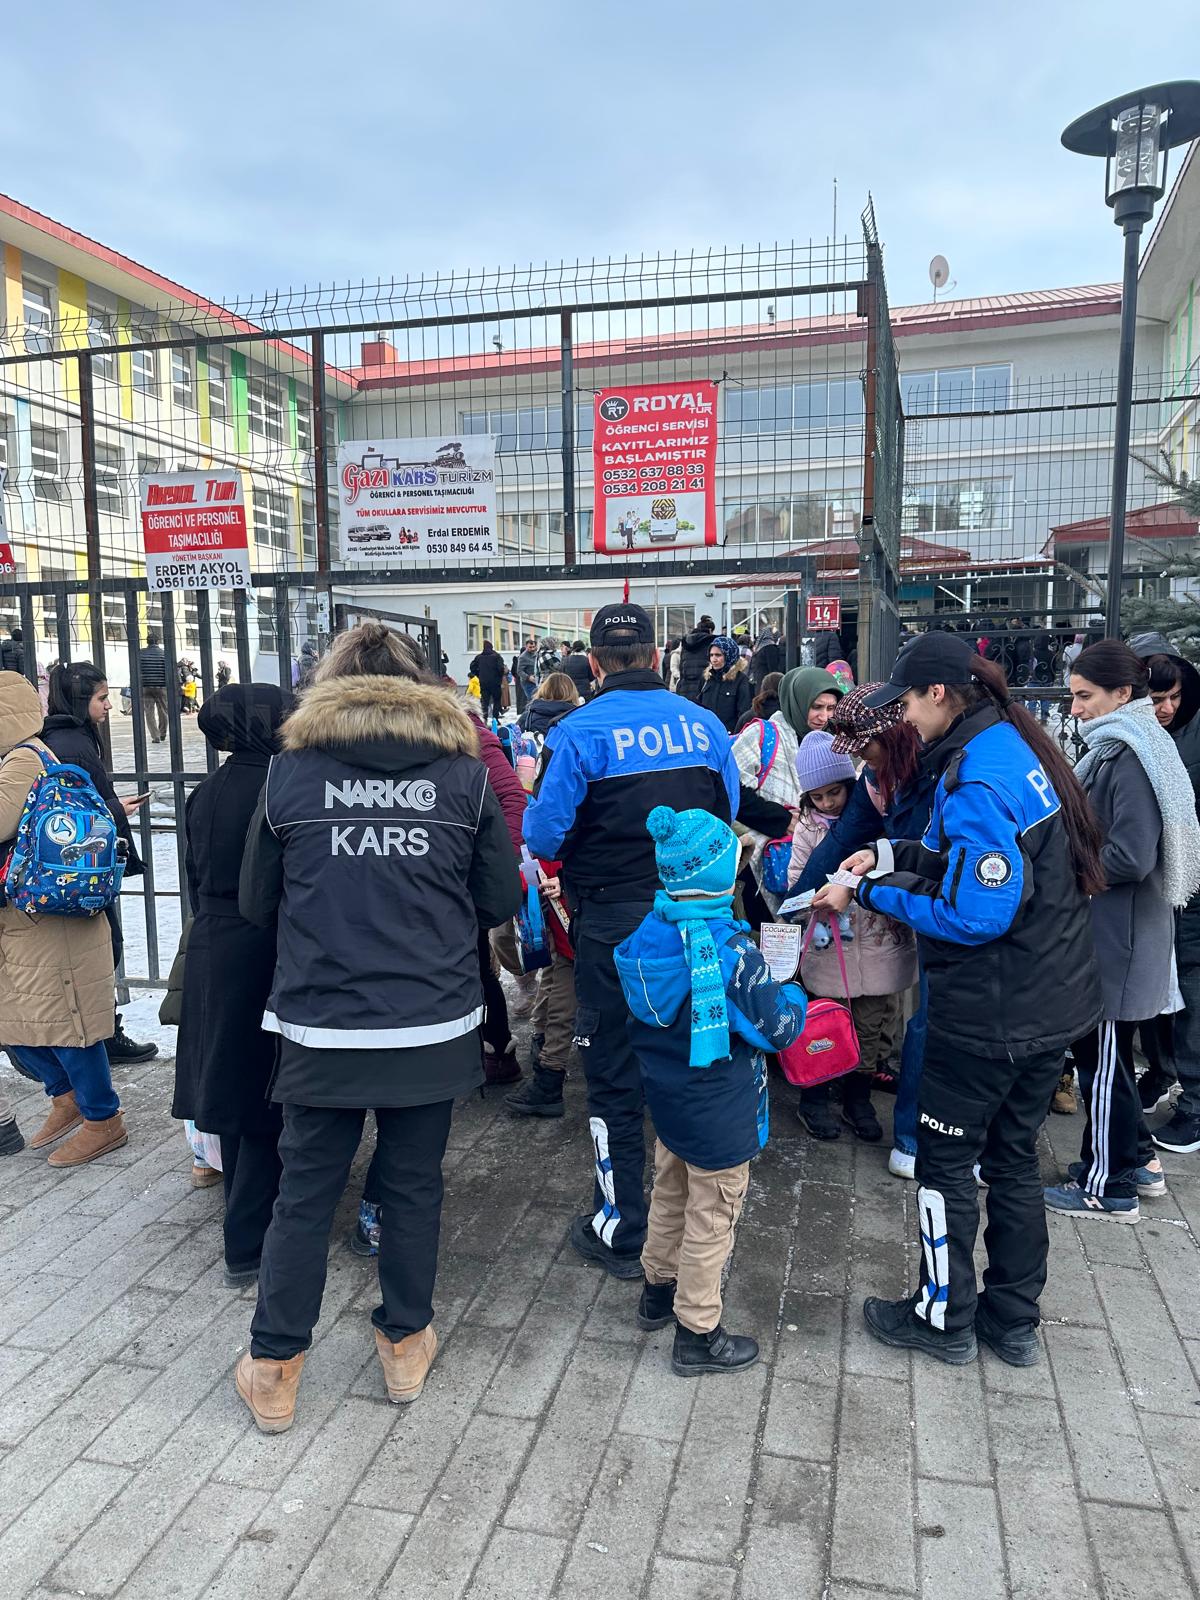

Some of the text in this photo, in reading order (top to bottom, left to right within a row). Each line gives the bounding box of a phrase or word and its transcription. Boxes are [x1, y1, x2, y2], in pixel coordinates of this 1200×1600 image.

[633, 392, 712, 412] ROYAL
[608, 406, 624, 418] RT
[689, 406, 713, 415] TUR
[606, 418, 709, 435] ÖĞRENCİ SERVİSİ
[602, 436, 709, 452] KAYITLARIMIZ
[604, 449, 706, 465] BAŞLAMIŞTIR
[392, 467, 438, 487] KARS
[440, 468, 493, 484] TURİZM
[603, 464, 704, 481] 0532 637 88 33
[370, 490, 396, 499] ÖĞRENCİ
[402, 490, 433, 498] PERSONEL
[434, 488, 475, 497] TAŞIMACILIĞI
[603, 478, 704, 494] 0534 208 21 41
[356, 505, 487, 517] TÜM OKULLARA SERVİSİMİZ MEVCUTTUR
[148, 511, 241, 529] ÖĞRENCİ VE PERSONEL
[168, 529, 223, 549] TAŞIMACILIĞI
[427, 525, 490, 538] Erdal ERDEMİR
[426, 542, 493, 554] 0530 849 64 45
[172, 552, 223, 562] YÖNETİM BAŞKANI
[156, 562, 243, 576] ERDEM AKYOL
[156, 575, 244, 588] 0561 612 05 13
[815, 606, 830, 620] 14
[612, 714, 710, 761] POLİS
[331, 826, 430, 856] KARS
